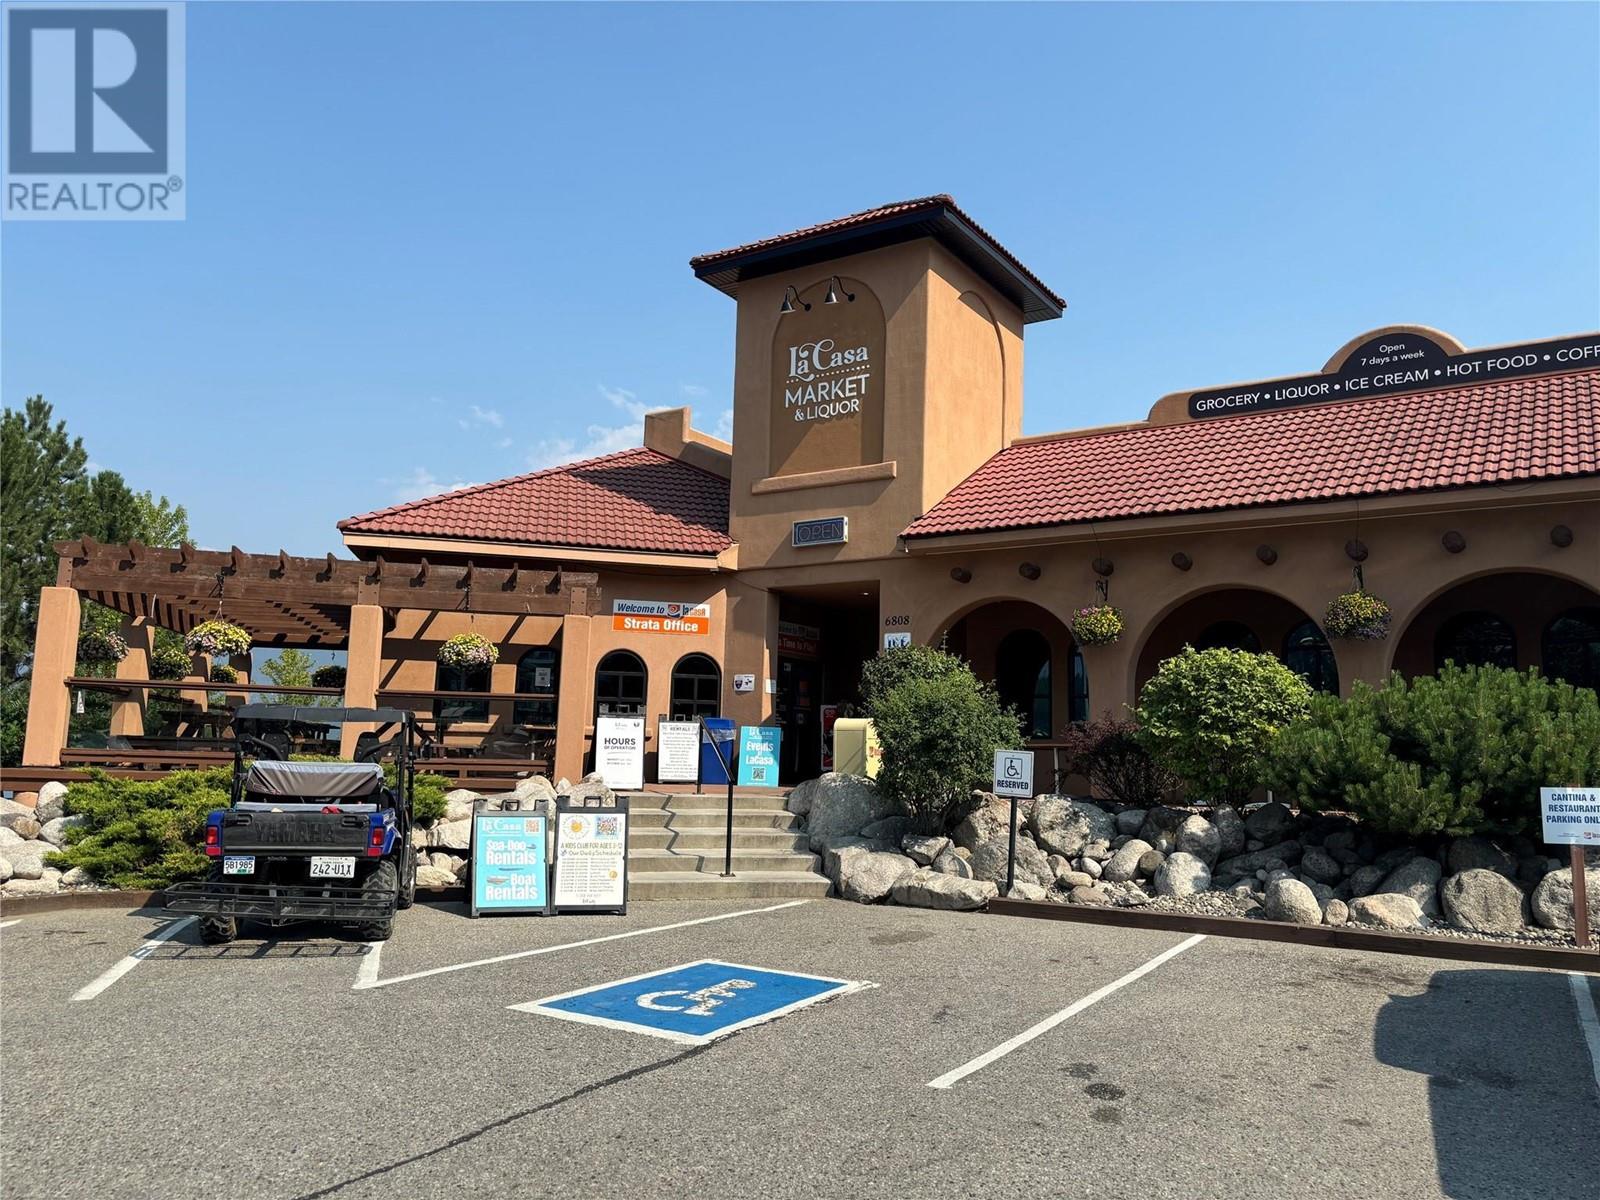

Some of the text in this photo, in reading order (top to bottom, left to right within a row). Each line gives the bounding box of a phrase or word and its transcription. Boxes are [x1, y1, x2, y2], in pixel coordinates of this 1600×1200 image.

[1379, 344, 1405, 354] Open
[1361, 358, 1367, 366] 7
[1369, 356, 1390, 366] days
[1400, 350, 1425, 360] week
[1196, 344, 1600, 411] GROCERY LIQUOR ICE CREAM HOT FOOD COFF
[785, 373, 870, 408] MARKET
[795, 399, 860, 421] & LIQUOR
[798, 523, 843, 541] OPEN
[617, 603, 655, 613] Welcome
[656, 604, 665, 614] to
[624, 617, 698, 632] Strata Office
[885, 615, 910, 626] 6808
[604, 737, 636, 746] HOURS
[996, 780, 1029, 790] RESERVED
[1551, 793, 1596, 802] CANTINA &
[1548, 804, 1600, 813] RESTAURANT
[1546, 815, 1600, 824] PARKING ONL
[486, 850, 537, 865] Rentals
[510, 873, 537, 886] Boat
[486, 886, 538, 901] Rentals
